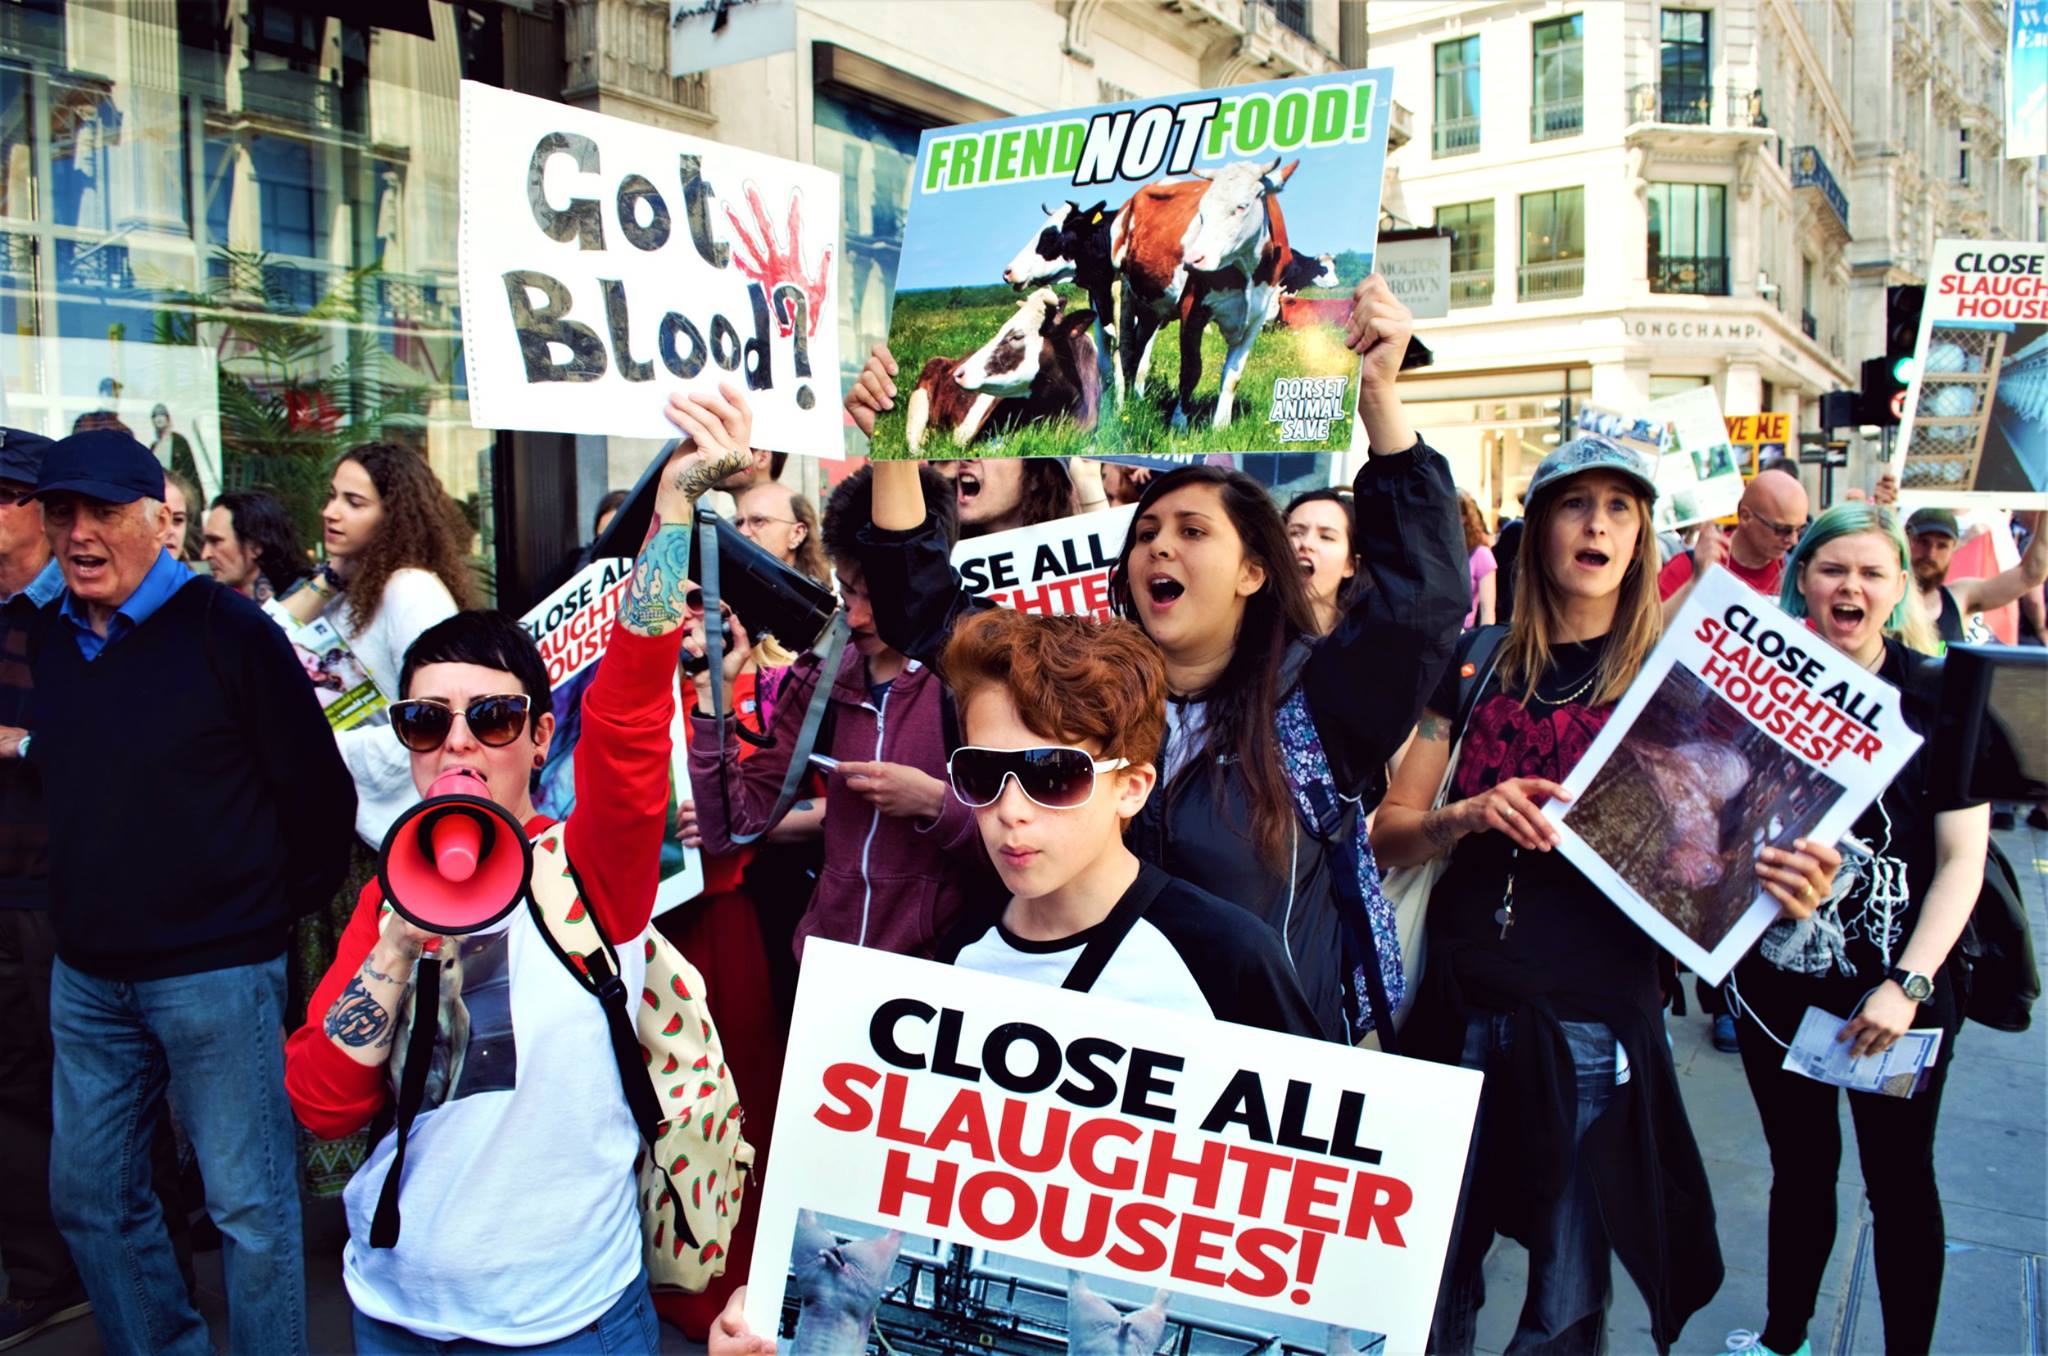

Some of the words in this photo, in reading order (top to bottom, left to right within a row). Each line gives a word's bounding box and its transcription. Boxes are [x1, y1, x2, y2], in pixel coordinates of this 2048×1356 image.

[923, 120, 1086, 191] FRIEND
[1073, 98, 1222, 186] NOT
[1205, 82, 1375, 158] FOOD!
[527, 131, 730, 269] Got
[1954, 252, 2045, 275] CLOSE
[502, 269, 816, 410] Blood?
[1624, 322, 1756, 337] LONGCHAMP
[1271, 398, 1344, 420] ANIMAL
[1275, 378, 1346, 400] DORSET
[1282, 418, 1328, 439] SAVE
[1756, 414, 1786, 440] ME
[527, 579, 593, 641] LOSE
[600, 557, 638, 594] AL
[1031, 532, 1118, 582] ALL
[1694, 617, 1883, 763] SLAUGHTER
[1700, 654, 1845, 768] HOUSES!
[1724, 604, 1826, 688] CLOSE
[1821, 680, 1883, 732] ALL
[869, 998, 1186, 1124] CLOSE
[1199, 1069, 1384, 1165] ALL
[813, 1062, 1414, 1248] SLAUGHTER
[877, 1149, 1327, 1306] HOUSES!
